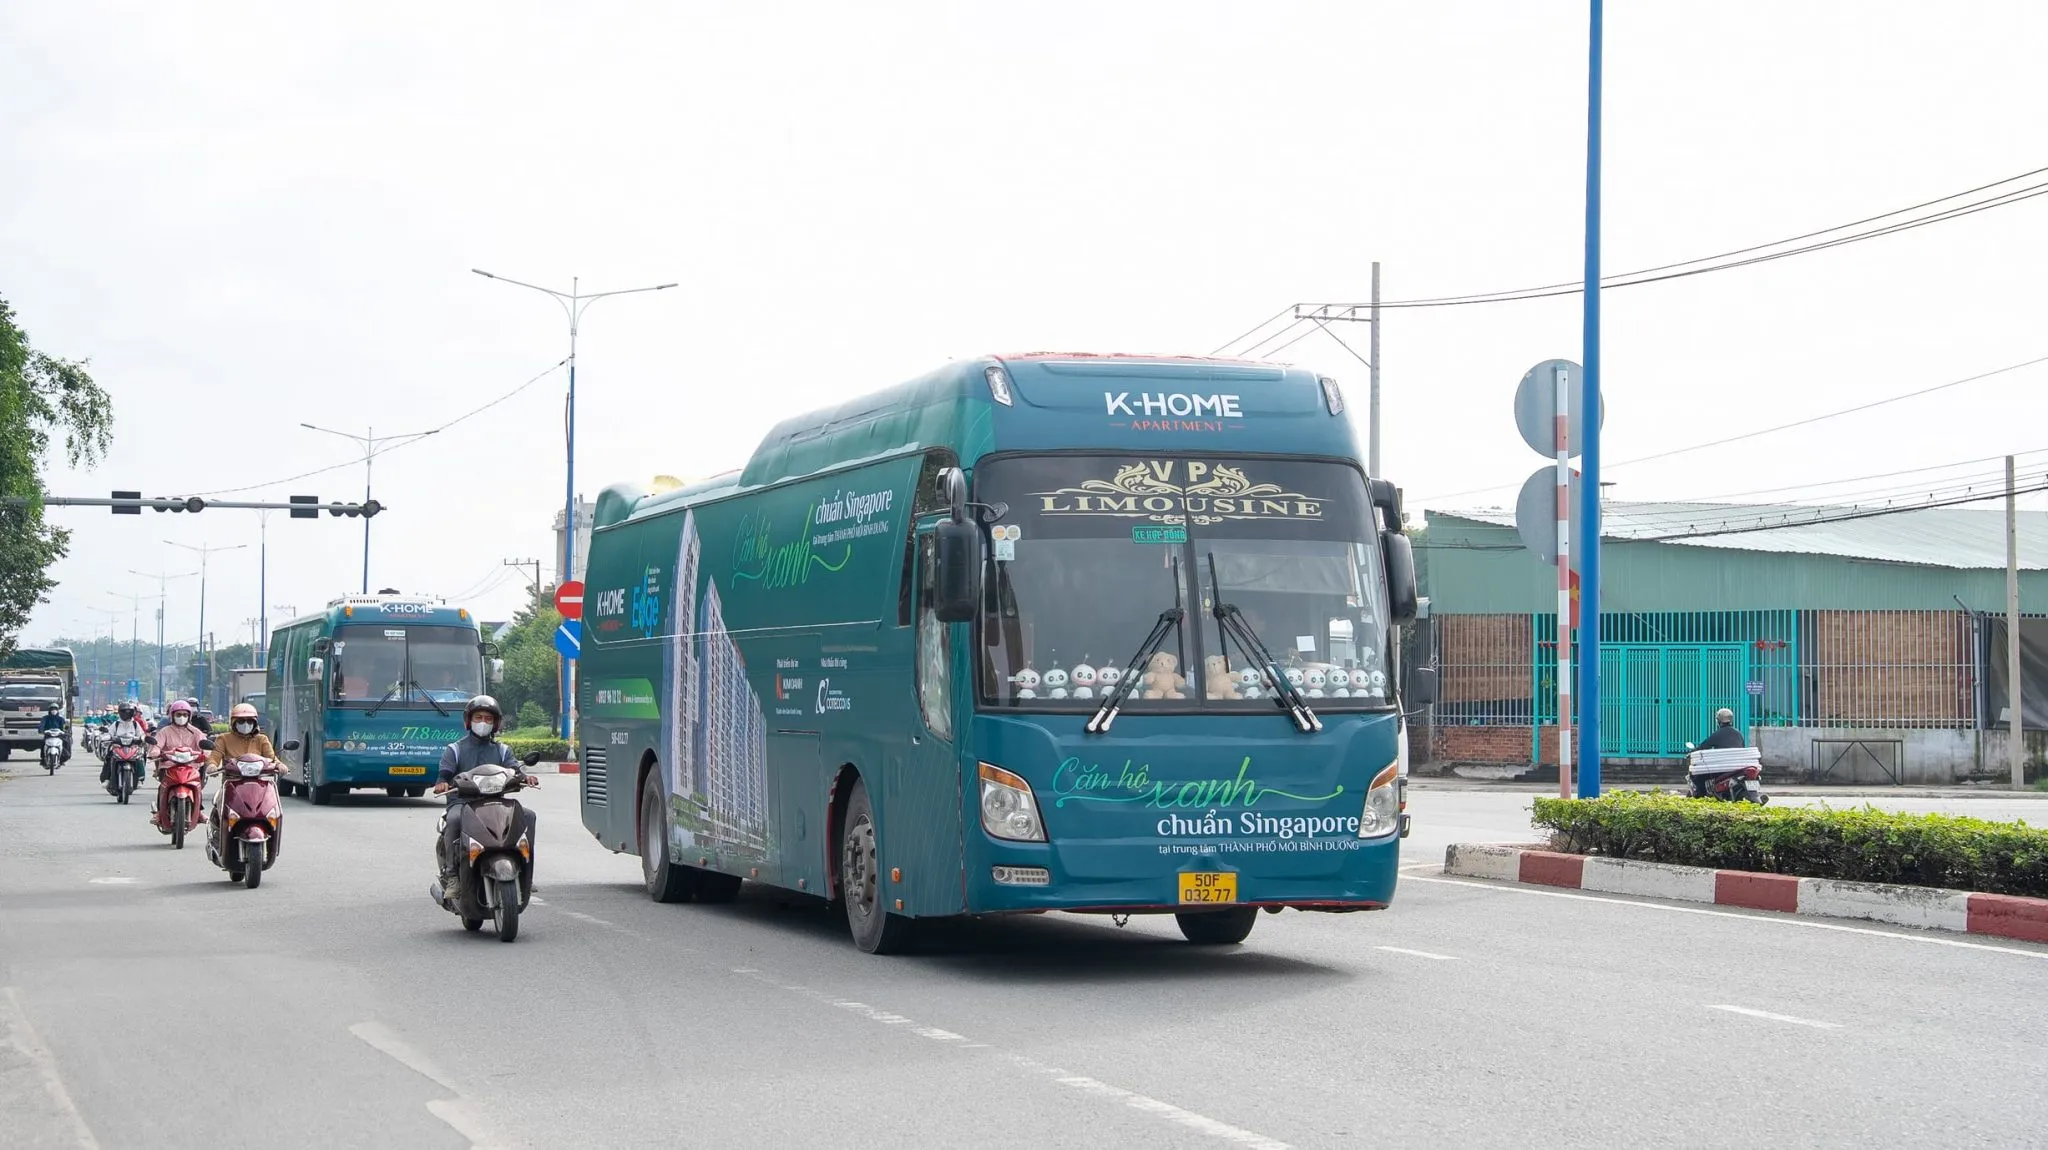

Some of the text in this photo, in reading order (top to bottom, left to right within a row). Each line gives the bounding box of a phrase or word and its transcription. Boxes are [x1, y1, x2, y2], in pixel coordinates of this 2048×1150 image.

[1105, 392, 1243, 417] K-HOME
[1131, 420, 1223, 432] APARTMENT
[815, 489, 893, 525] chuẩn Singapore
[1041, 496, 1323, 518] LIMOUSINE
[380, 603, 435, 614] K-HOME
[597, 588, 625, 616] K-HOME
[1052, 756, 1112, 795] Căn
[1115, 759, 1151, 793] hộ
[1157, 809, 1360, 839] chuẩn Singapore
[1159, 839, 1360, 855] tại trung tâm THÀNH PHỐ MỚI BÌNH DƯƠNG
[1194, 873, 1221, 888] 50F
[1184, 888, 1232, 902] 032.77
